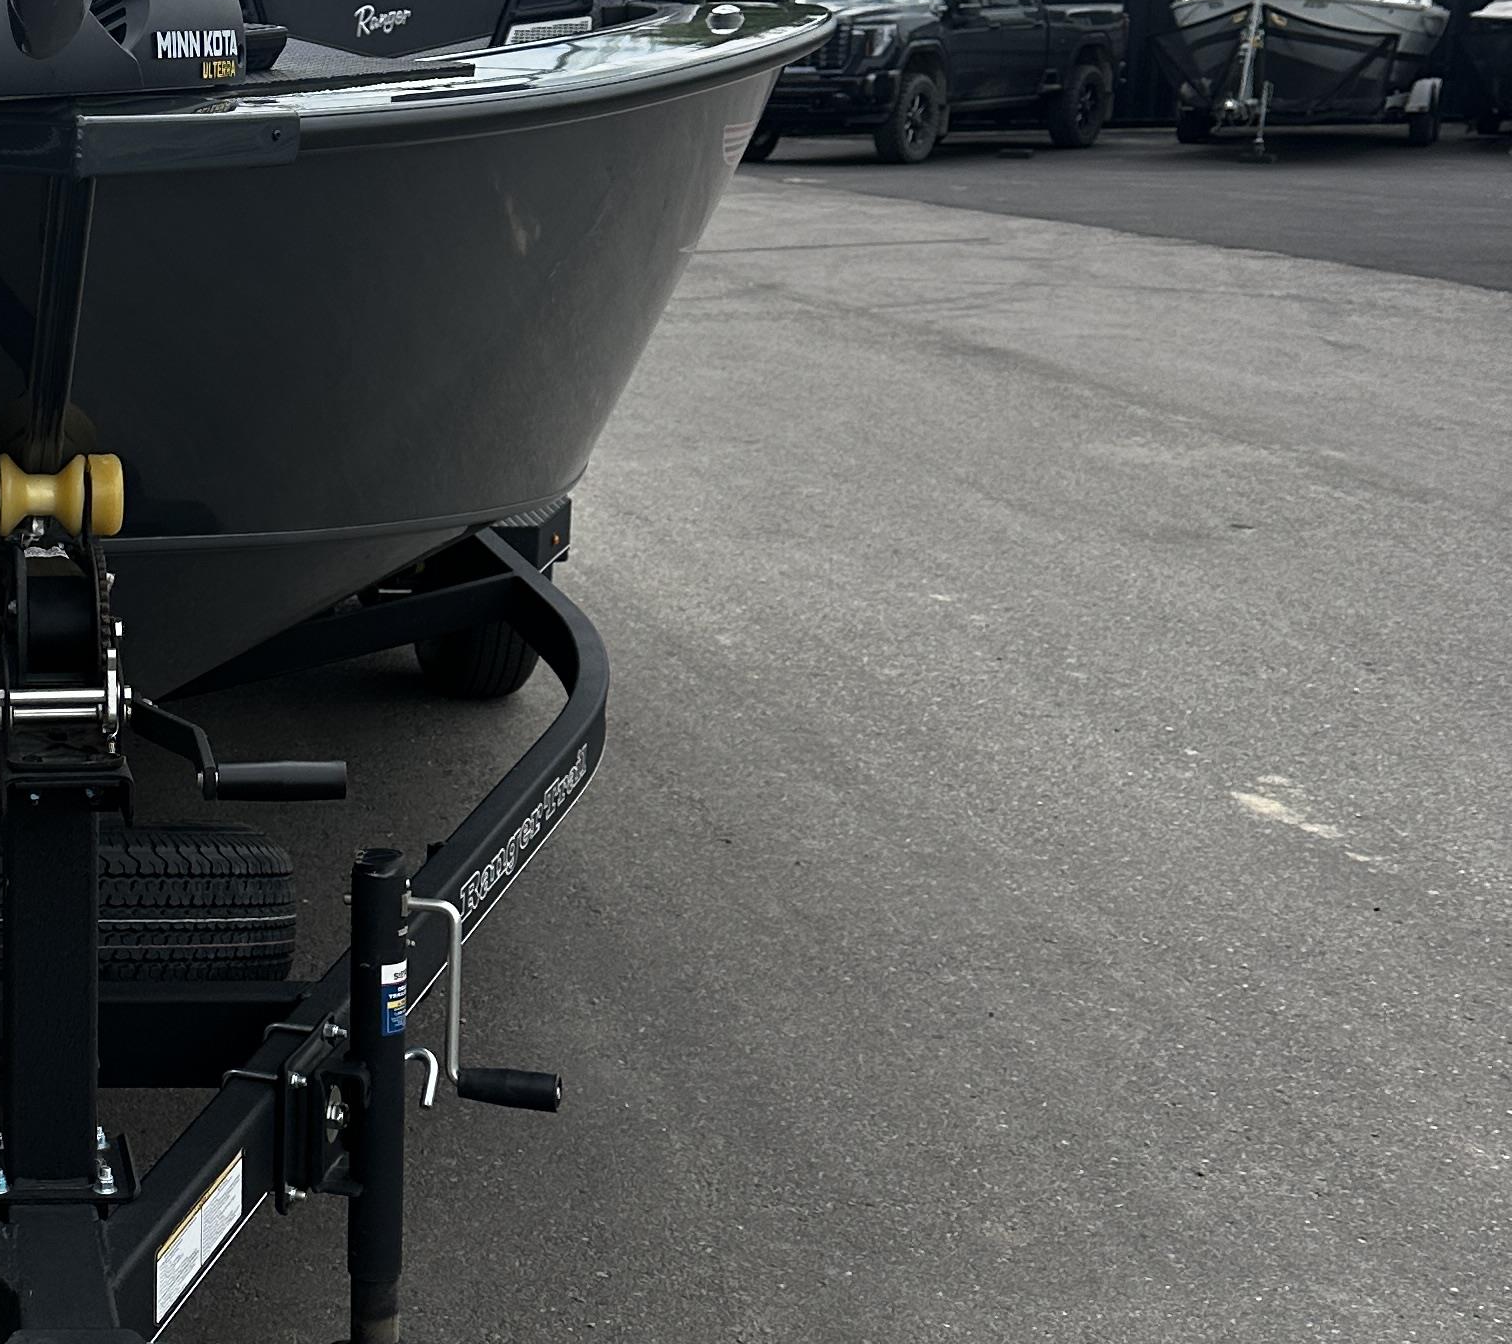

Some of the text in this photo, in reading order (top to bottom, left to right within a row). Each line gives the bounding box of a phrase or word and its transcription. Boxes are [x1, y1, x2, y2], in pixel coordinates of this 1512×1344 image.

[354, 5, 411, 37] Ranger
[156, 29, 238, 59] MINN KOTA
[202, 59, 236, 79] ULTERRA
[460, 802, 544, 923] Ranger
